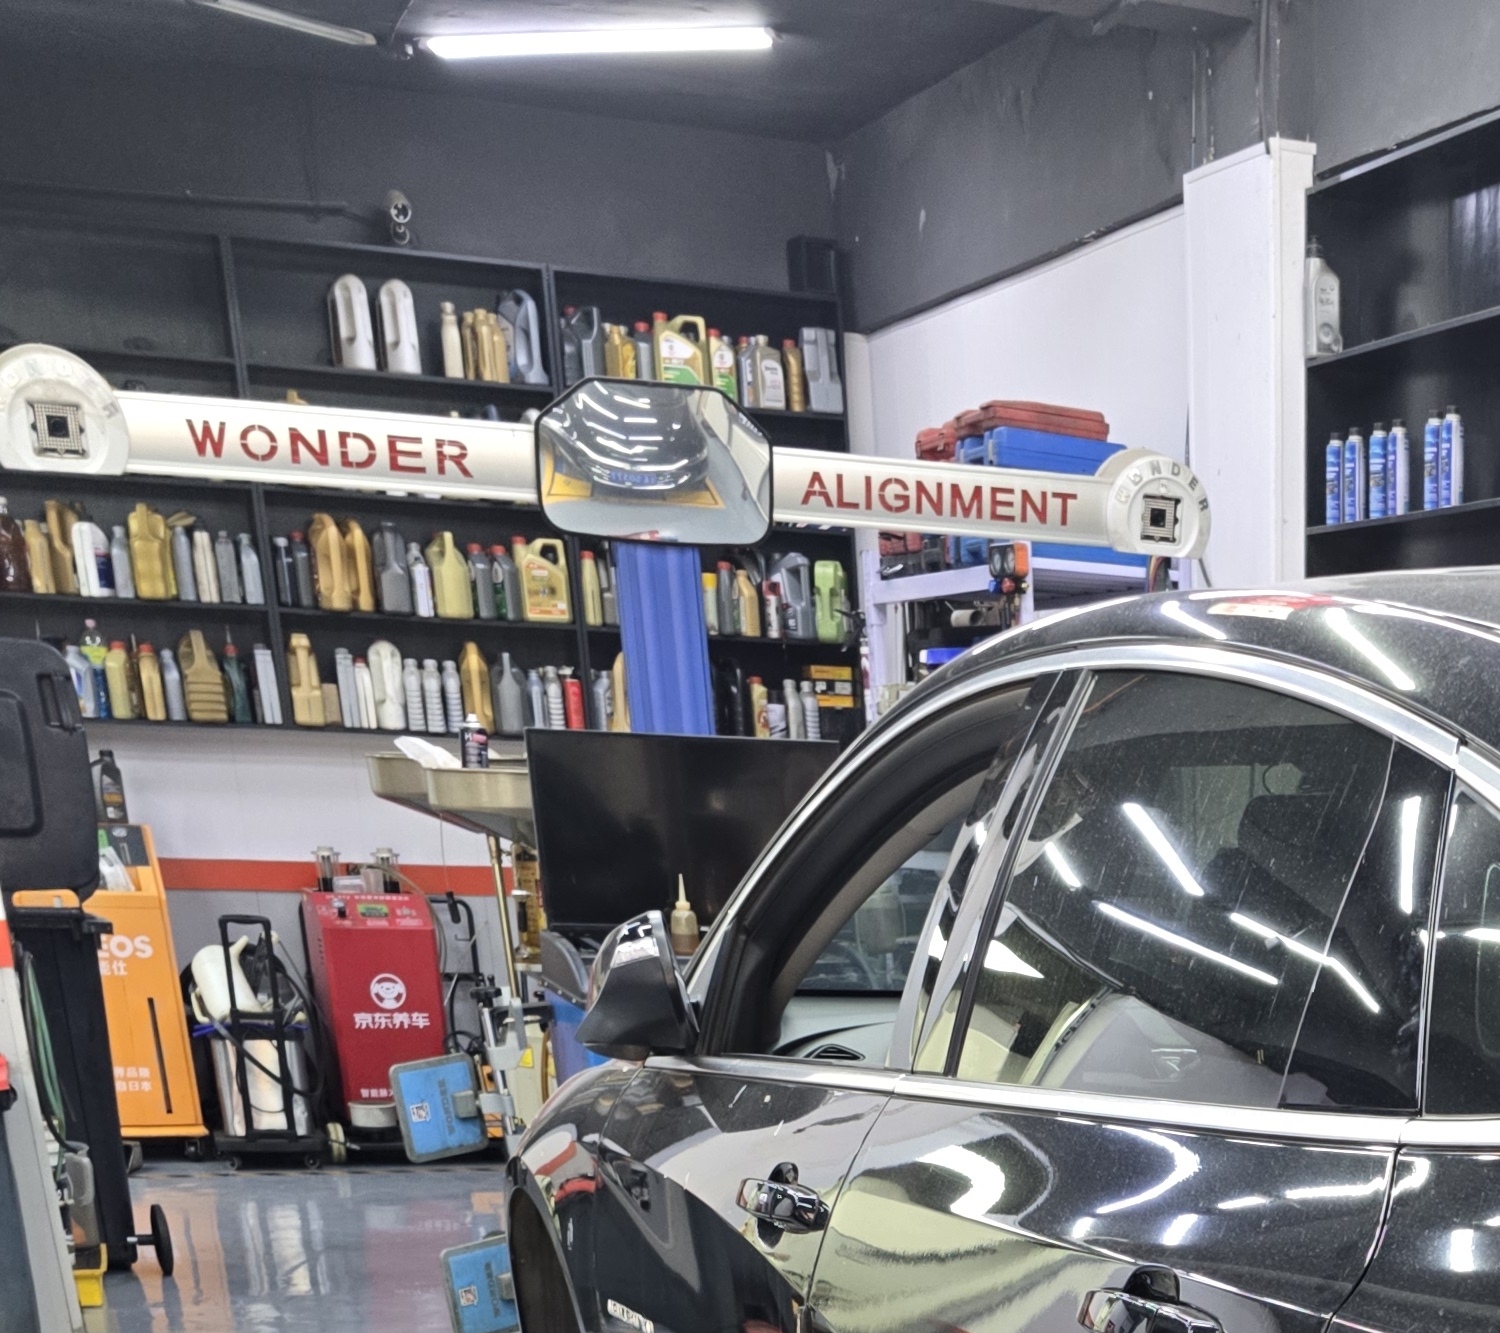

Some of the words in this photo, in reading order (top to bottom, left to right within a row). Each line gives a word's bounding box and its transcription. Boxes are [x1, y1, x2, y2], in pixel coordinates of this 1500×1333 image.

[185, 419, 474, 480] WONDER
[801, 471, 1078, 527] ALIGNMENT
[353, 1012, 430, 1029] 京东养车
